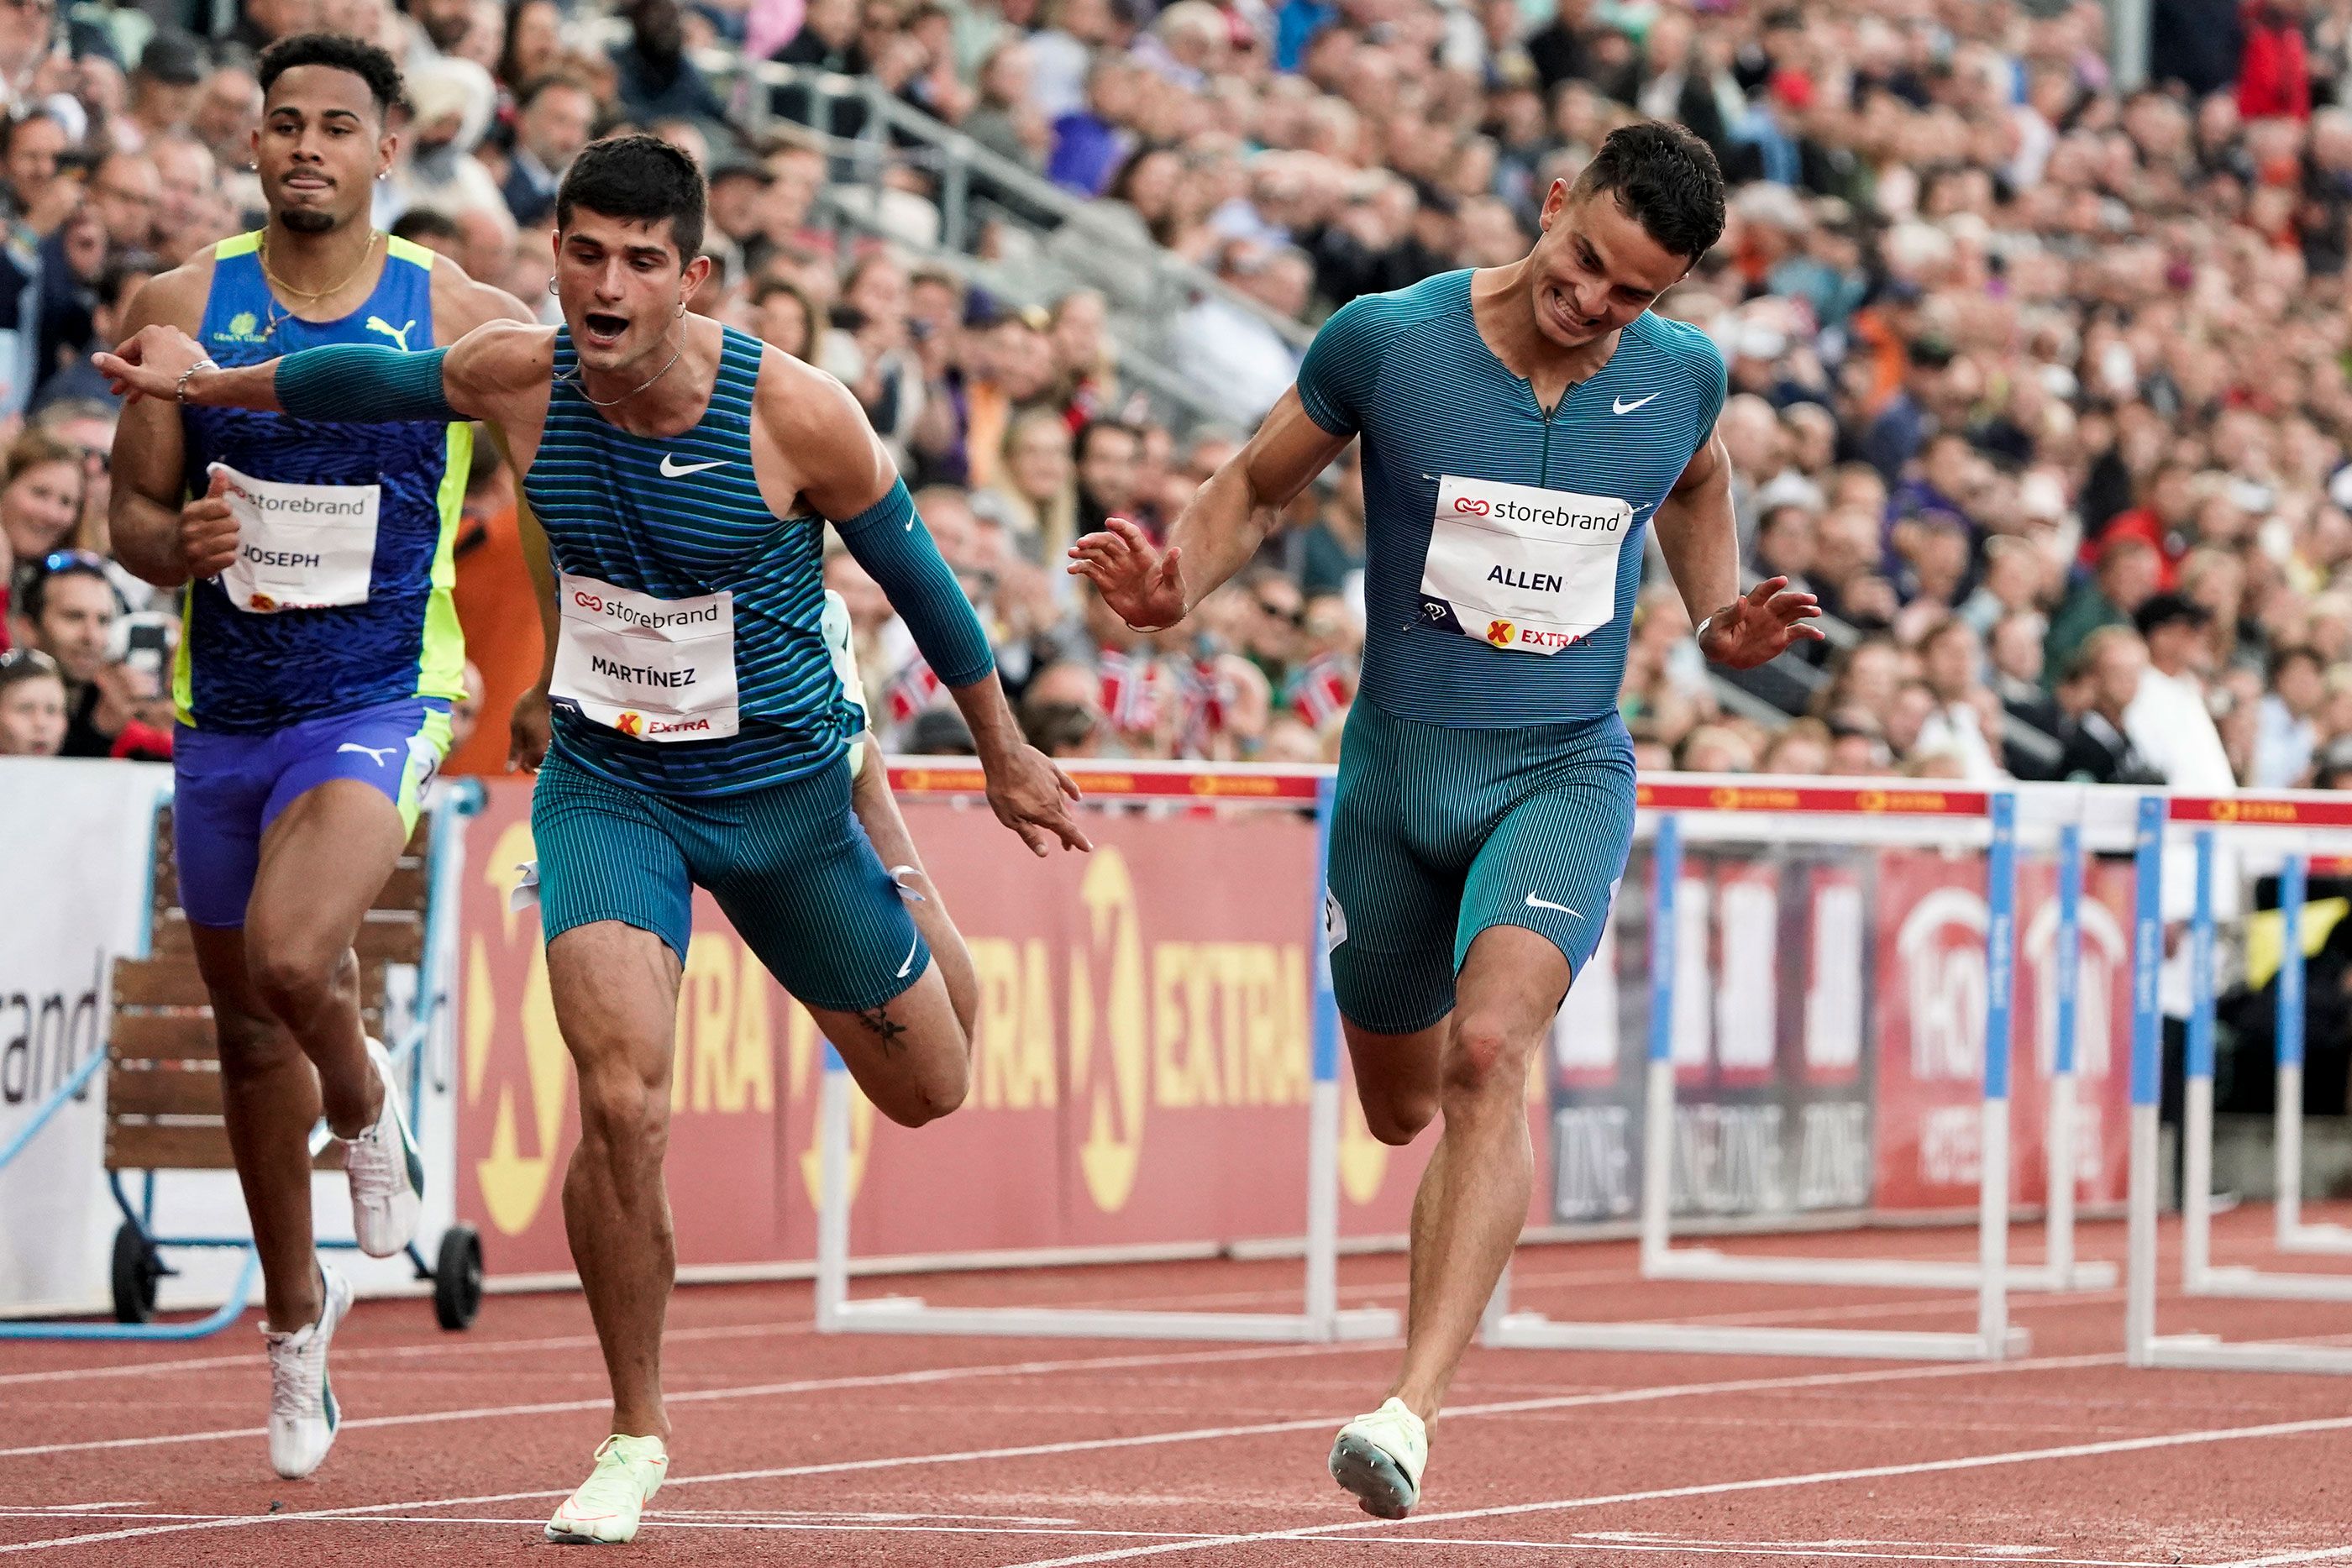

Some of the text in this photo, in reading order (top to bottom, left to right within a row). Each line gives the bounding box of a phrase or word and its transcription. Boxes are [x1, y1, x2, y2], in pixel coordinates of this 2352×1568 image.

[1494, 501, 1620, 532] storebrand
[243, 544, 321, 568] JOSEPH
[1487, 564, 1563, 593] ALLEN
[606, 600, 719, 629] storebrand
[591, 655, 696, 688] MARTÍNEZ
[648, 717, 711, 734] EXTRA
[1152, 941, 1311, 1109] EXTRA
